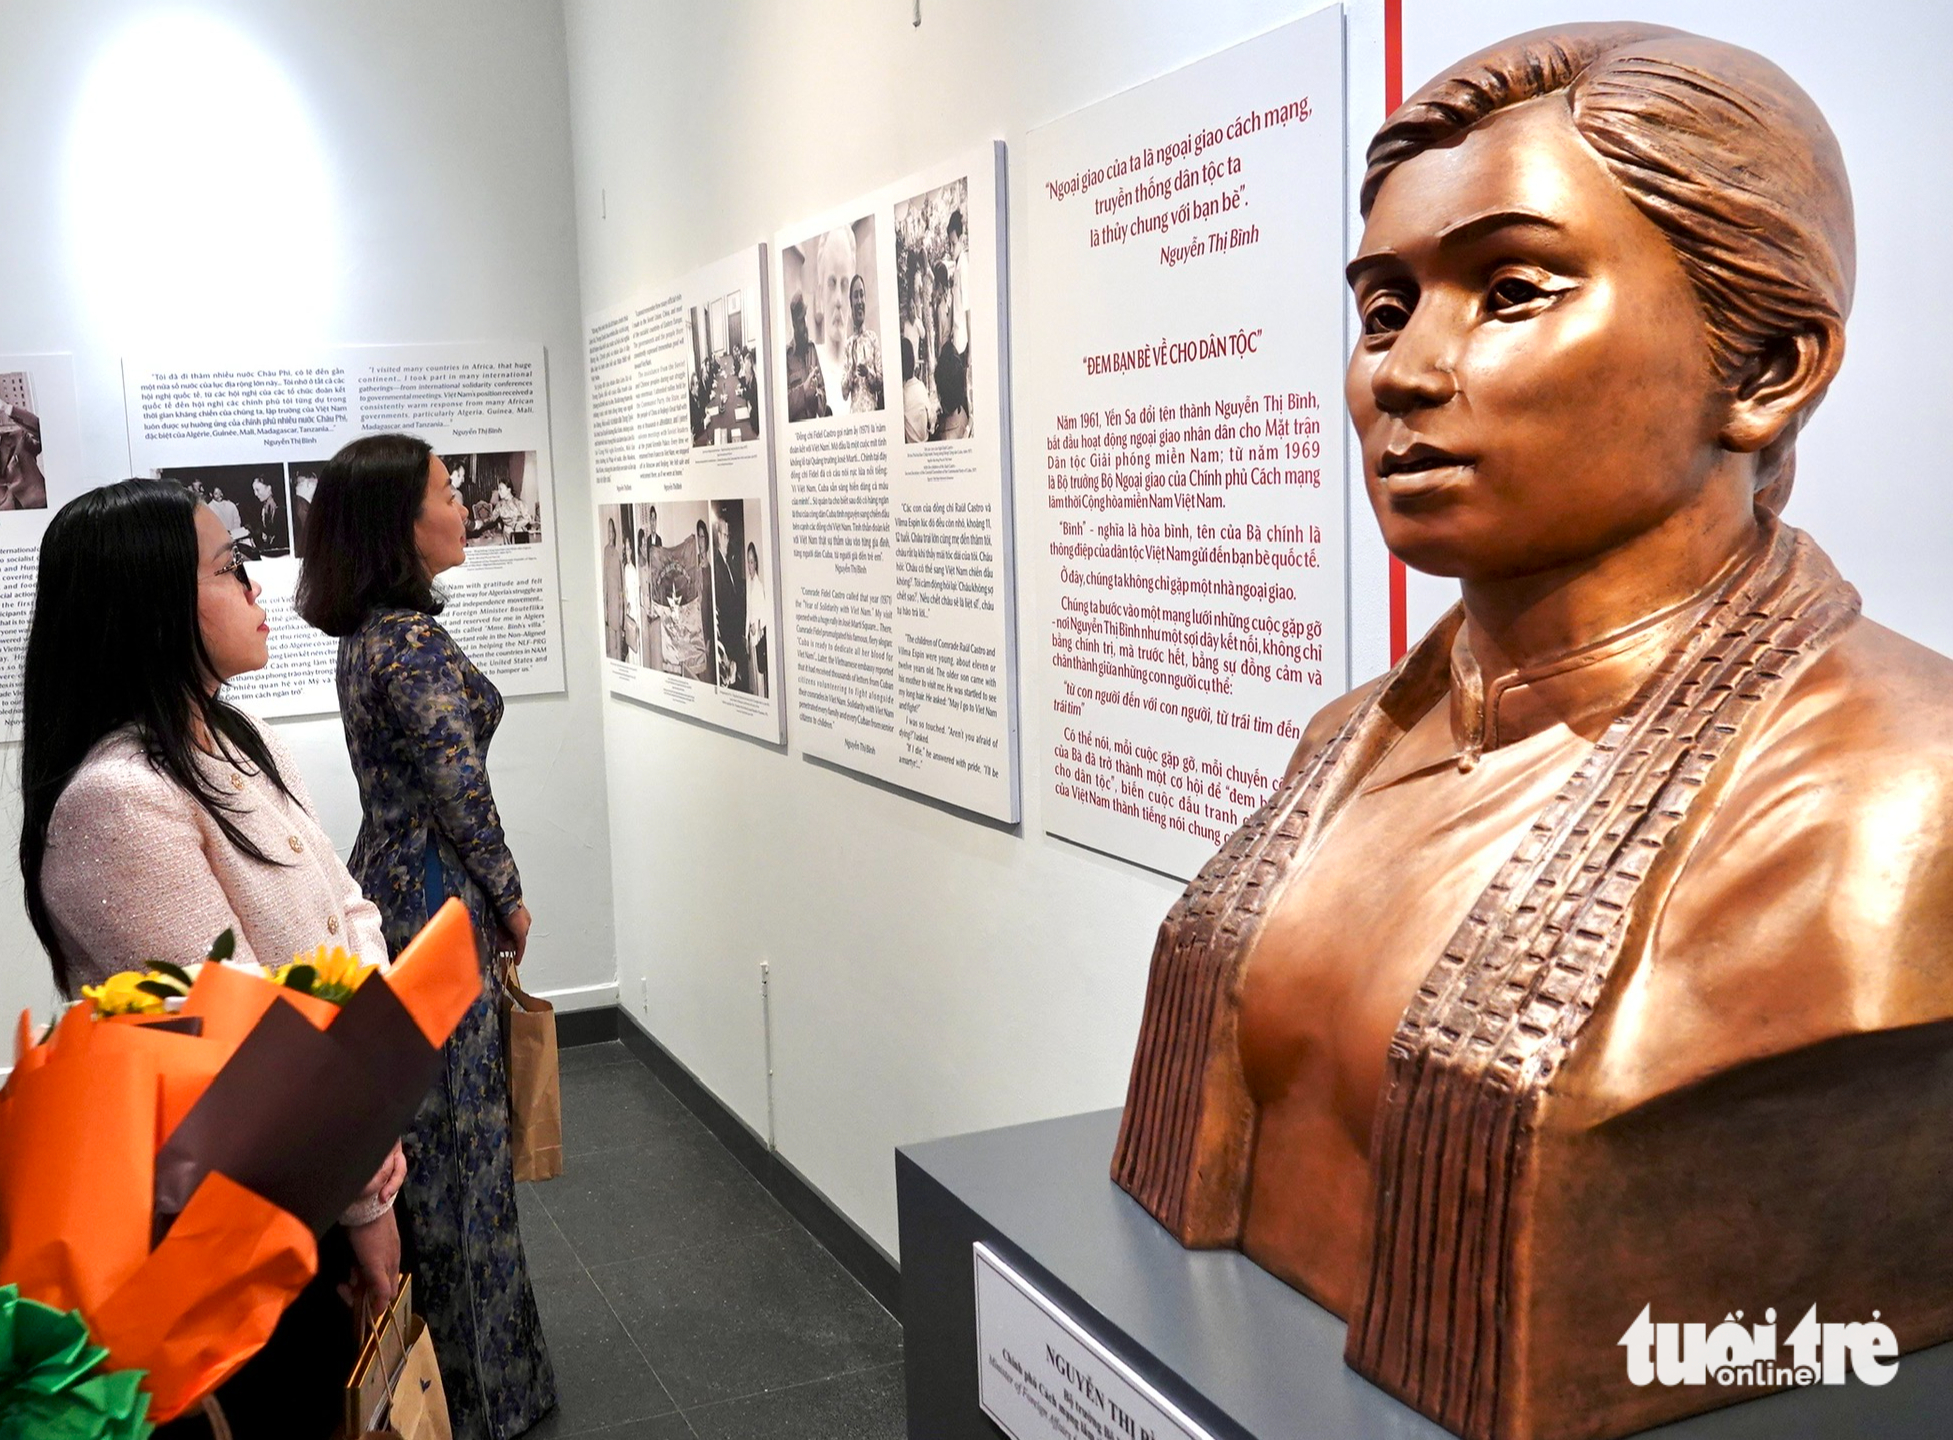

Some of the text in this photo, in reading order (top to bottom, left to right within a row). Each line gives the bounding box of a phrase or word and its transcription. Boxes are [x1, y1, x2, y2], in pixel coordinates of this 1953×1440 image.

[1045, 96, 1312, 202] “Ngoại giao của ta là ngoại giao cách mạng,
[1095, 156, 1241, 215] truyền thống dân tộc ta
[1090, 229, 1100, 248] là
[1102, 224, 1128, 245] thủy
[1130, 212, 1169, 236] chung
[1170, 202, 1190, 225] với
[1193, 199, 1219, 221] bạn
[1160, 224, 1259, 267] Nguyễn Thị Bình
[1083, 328, 1262, 376] “ĐEM BẠN BÈ VỀ CHO DÂN TỘC”
[514, 362, 532, 370] huge
[360, 403, 405, 411] consistently
[412, 410, 455, 419] particularly
[1057, 391, 1320, 430] Năm 1961, Yến Sa đổi tên thành Nguyễn Thị Bình,
[1047, 416, 1320, 451] bắt đầu hoạt động ngoại giao nhân dân cho Mặt trận
[1048, 440, 1320, 471] Dân tộc Giải phóng miền Nam; từ năm 1969
[1048, 467, 1321, 493] là Bộ trưởng Bộ Ngoại giao của Chính phủ Cách mạng
[1059, 521, 1085, 536] “Bình”
[1098, 522, 1124, 541] nghĩa
[1128, 522, 1137, 537] là
[1141, 522, 1160, 538] hòa
[1164, 523, 1192, 541] bình,
[1197, 524, 1215, 539] tên
[1220, 524, 1241, 540] của
[1246, 524, 1261, 542] Bà
[1266, 524, 1304, 543] chính
[1310, 525, 1321, 544] là
[2, 573, 34, 582] covering
[3, 582, 18, 590] and
[1, 601, 15, 609] the
[479, 607, 508, 615] Minister
[476, 661, 487, 669] the
[489, 658, 512, 667] United
[535, 655, 548, 663] and
[1054, 699, 1085, 716] trái tim”
[1064, 681, 1301, 740] “từ con người đến với con người, từ trái tim đến
